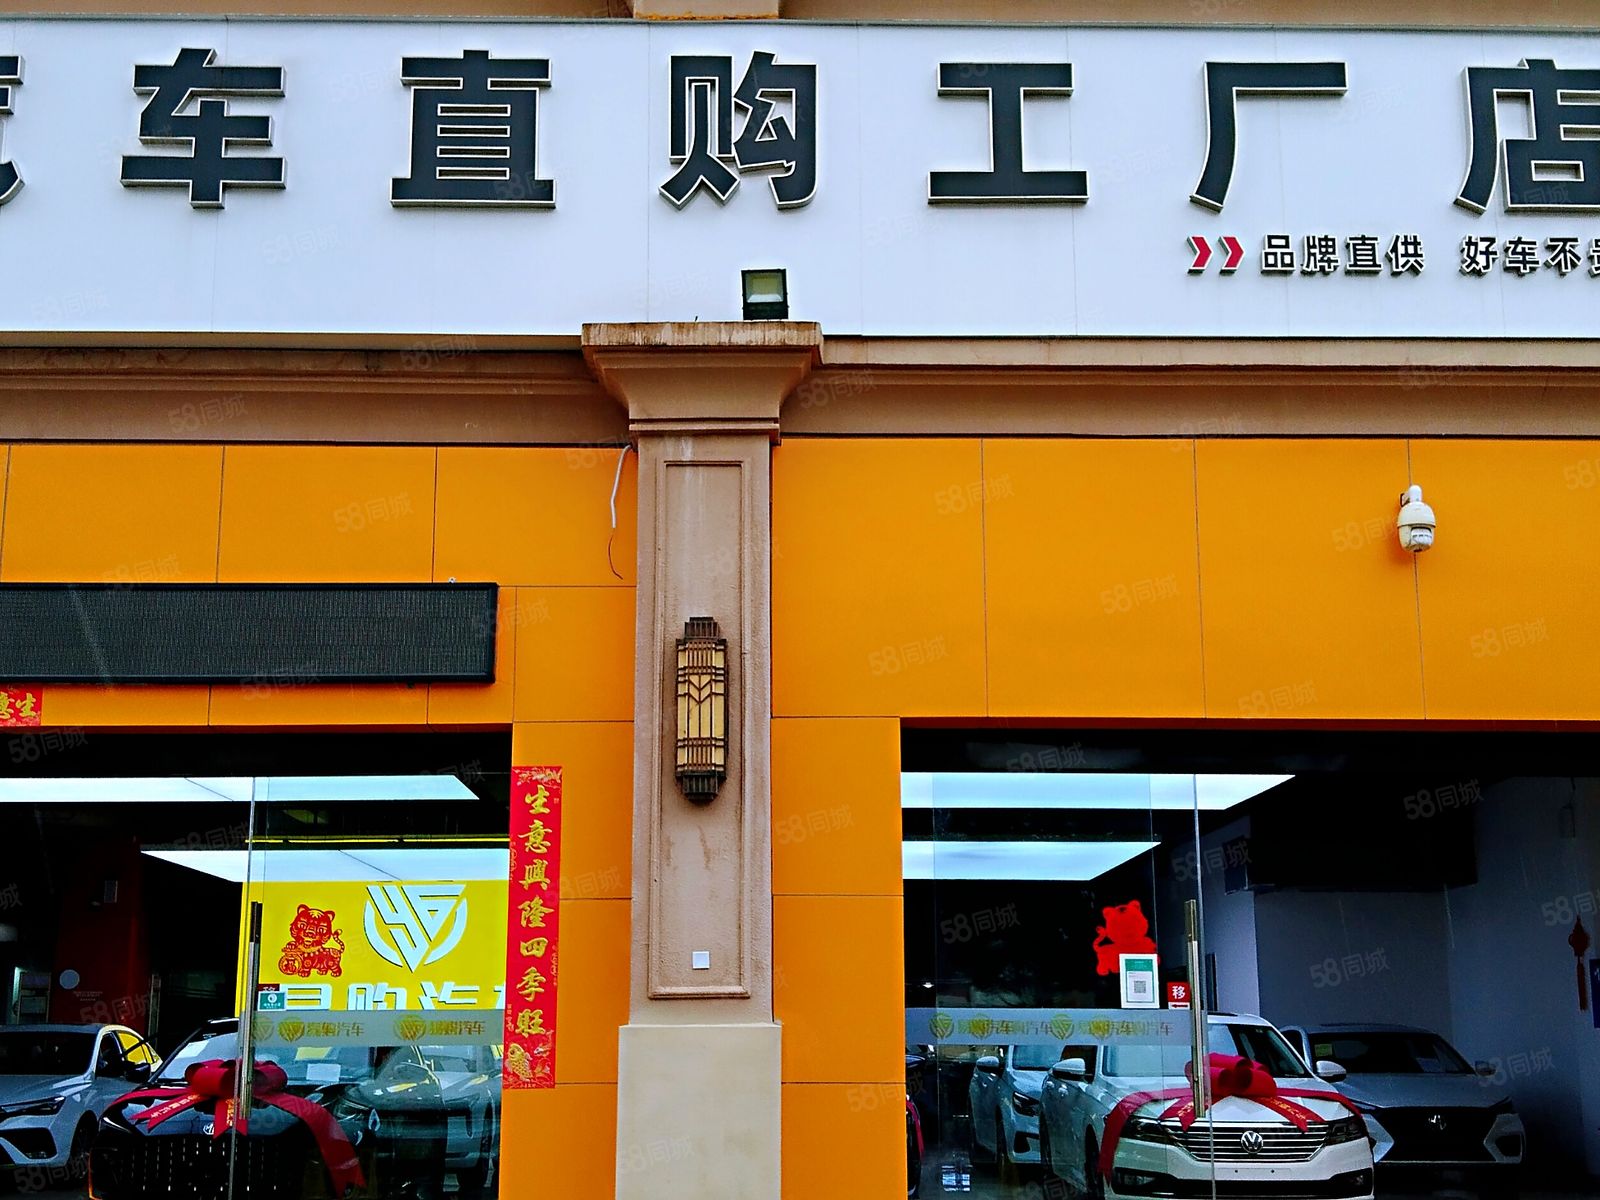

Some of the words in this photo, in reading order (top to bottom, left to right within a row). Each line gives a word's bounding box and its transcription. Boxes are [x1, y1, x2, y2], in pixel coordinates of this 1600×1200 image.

[0, 48, 1600, 214] 车直购工厂店
[1262, 234, 1425, 275] 品牌直供
[1172, 985, 1186, 999] 移
